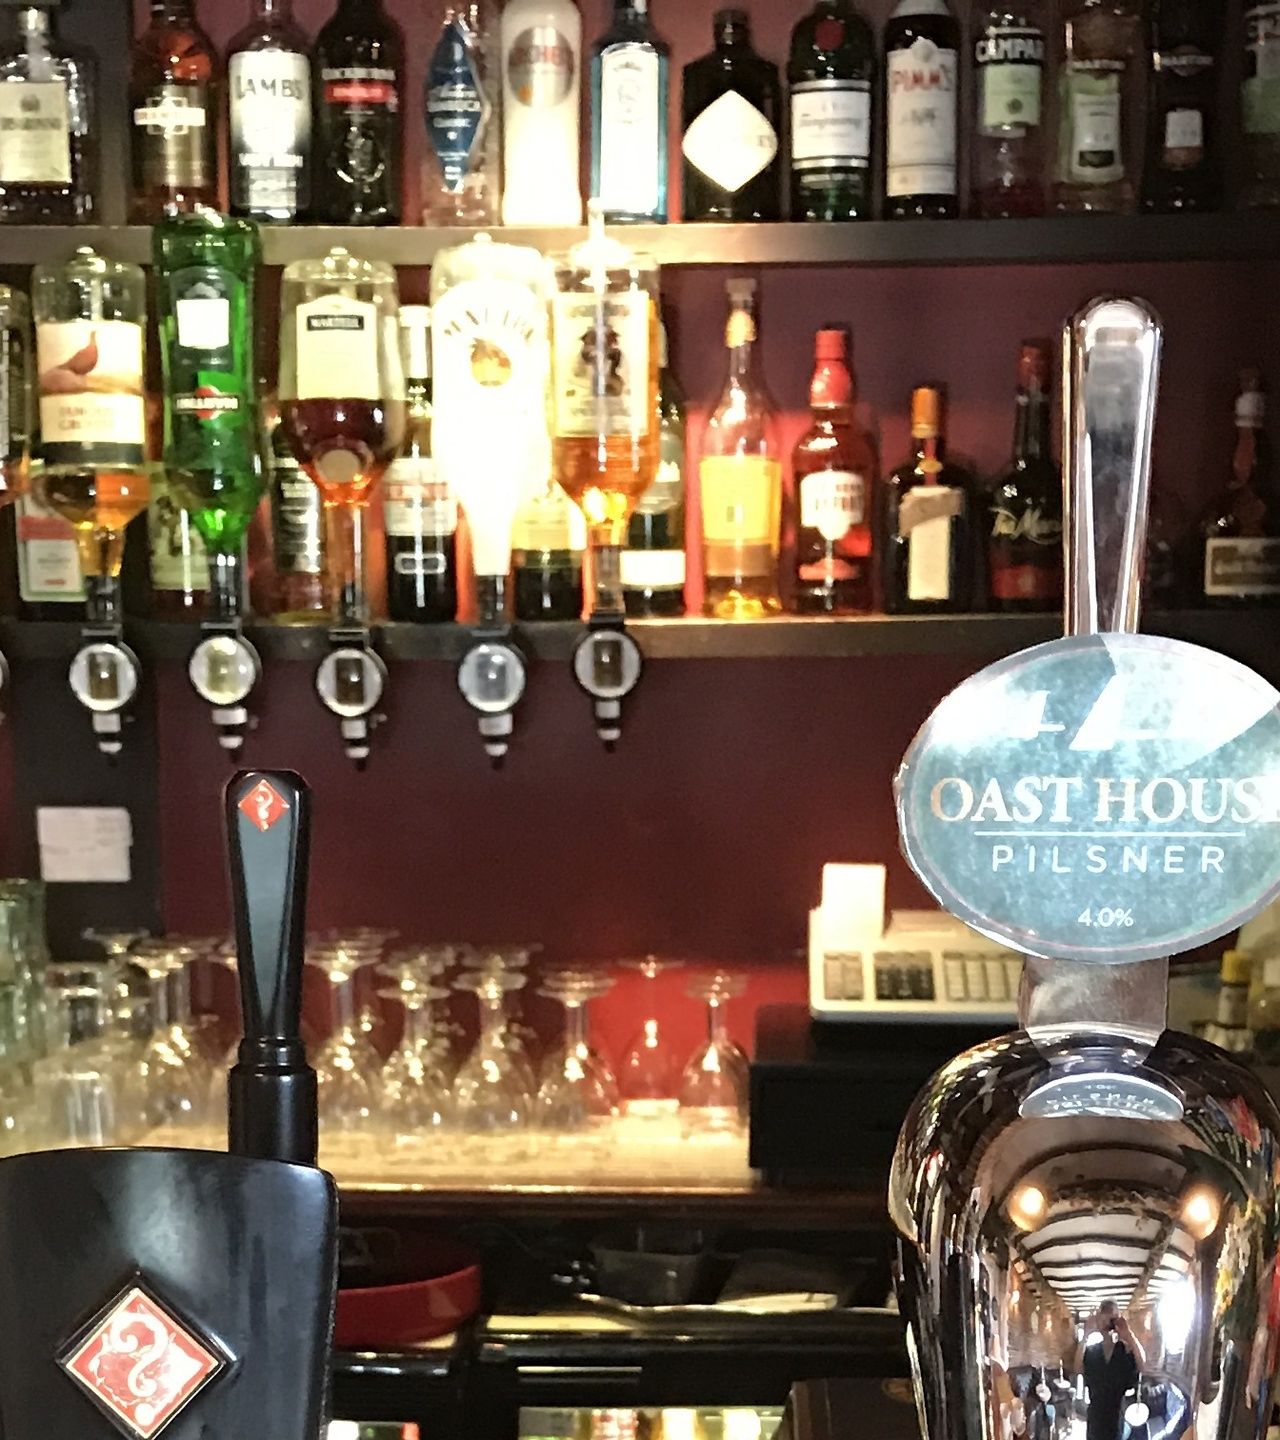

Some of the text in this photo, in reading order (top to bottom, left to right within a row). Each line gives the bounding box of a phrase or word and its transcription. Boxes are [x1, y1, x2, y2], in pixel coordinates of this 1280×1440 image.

[930, 776, 1086, 824] OAST
[991, 844, 1226, 874] PILSNER
[1077, 907, 1134, 930] 4.0%
